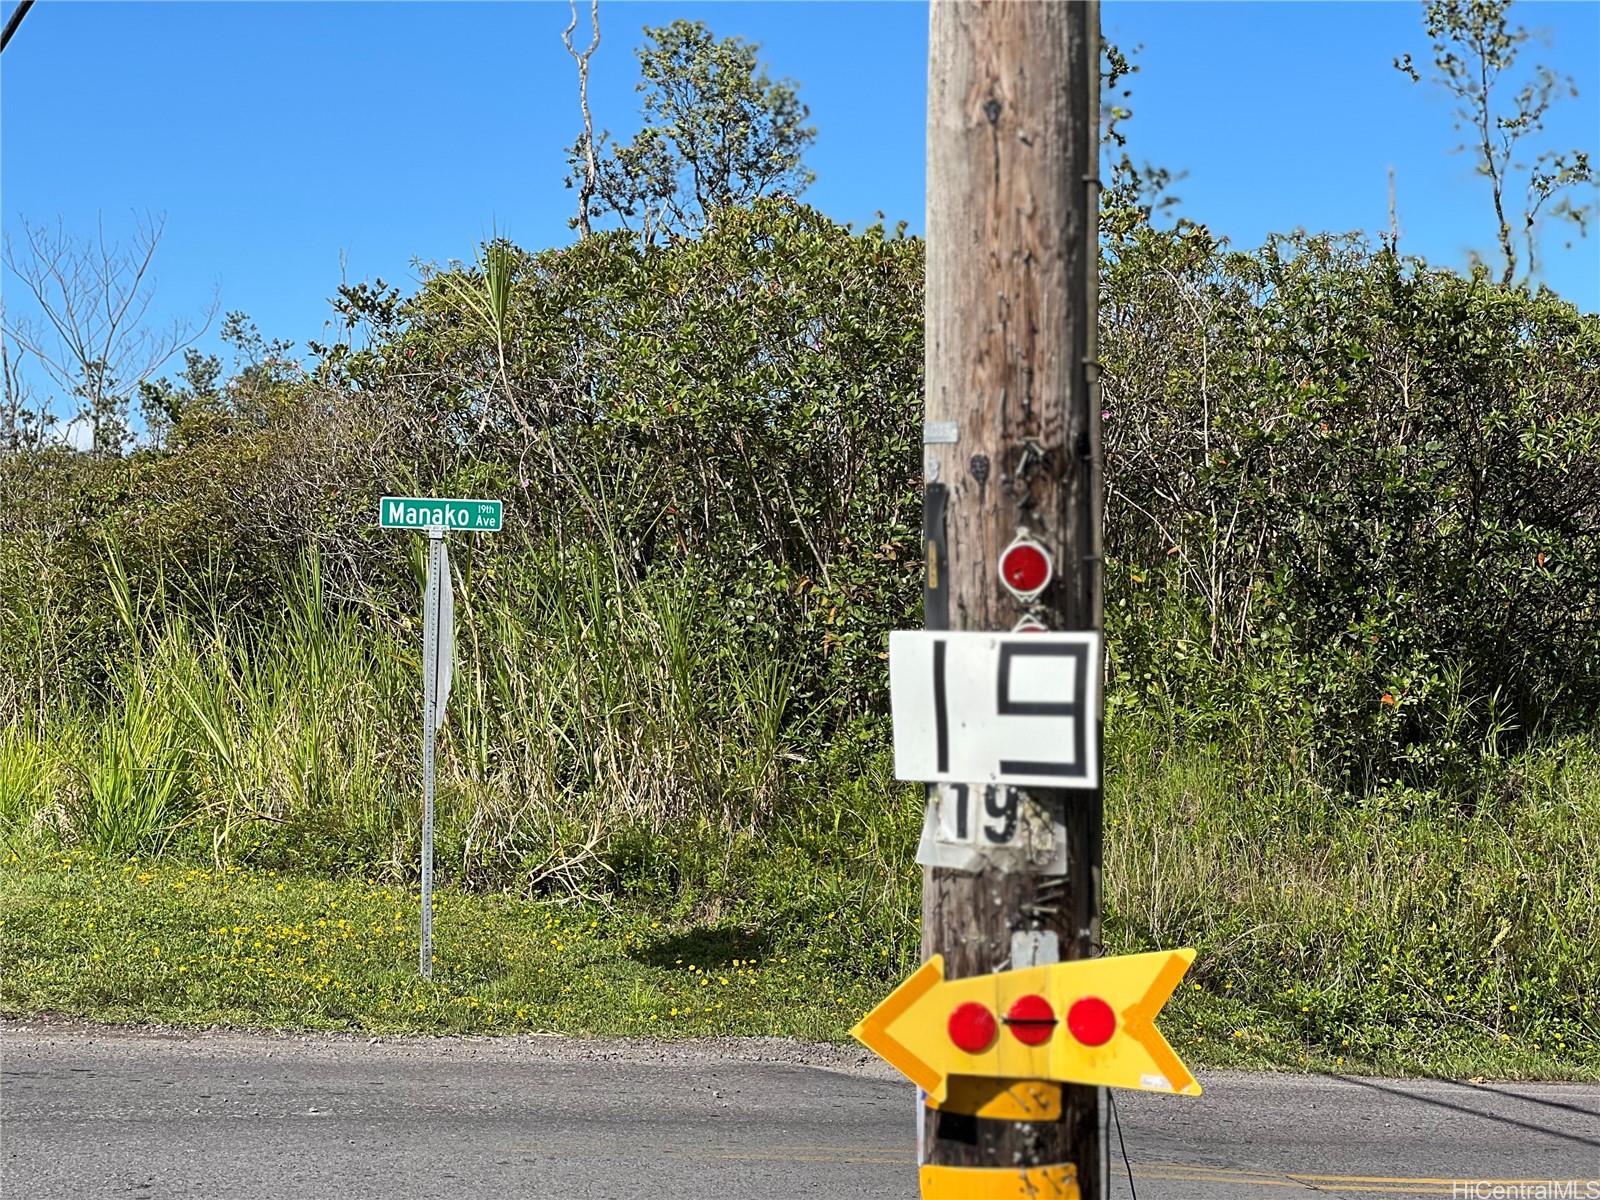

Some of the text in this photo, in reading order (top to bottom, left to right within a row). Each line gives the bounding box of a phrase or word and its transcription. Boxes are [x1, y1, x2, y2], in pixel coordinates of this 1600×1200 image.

[389, 501, 469, 526] Manako
[475, 514, 496, 527] Ave
[477, 504, 495, 514] 19th
[933, 640, 1090, 778] 19
[950, 783, 1018, 844] 19
